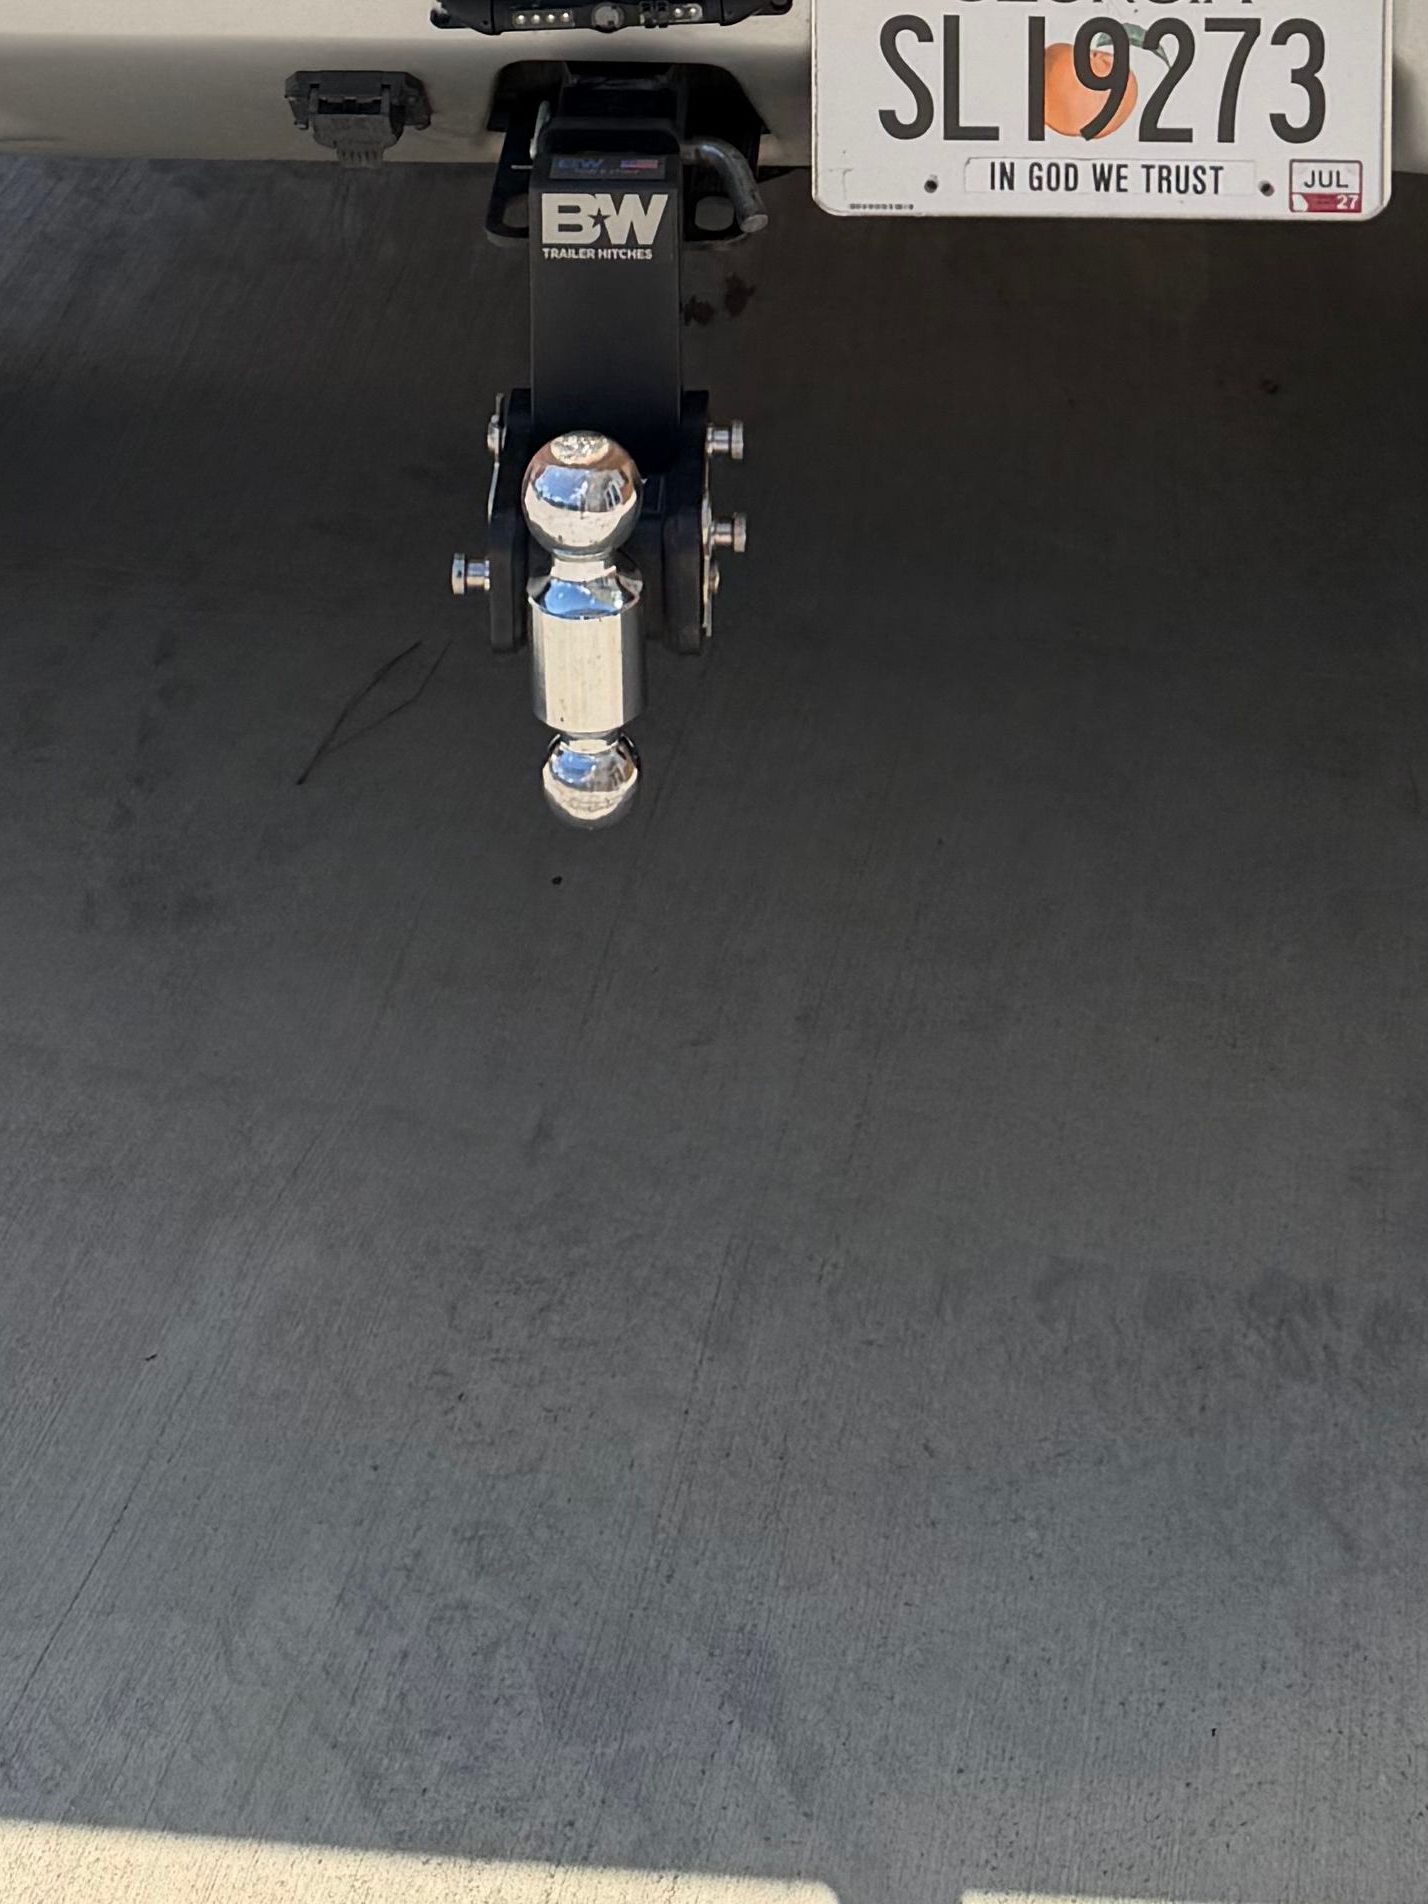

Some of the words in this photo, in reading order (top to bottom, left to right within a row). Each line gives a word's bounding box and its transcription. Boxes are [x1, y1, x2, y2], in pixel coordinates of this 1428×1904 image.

[989, 161, 1016, 191] IN
[1028, 162, 1079, 192] GOD
[1092, 163, 1129, 193] WE
[1141, 164, 1225, 195] TRUST
[1303, 169, 1349, 189] JUL
[1336, 194, 1360, 210] 27
[541, 248, 596, 260] TRAILER
[597, 248, 653, 260] HITCHES
